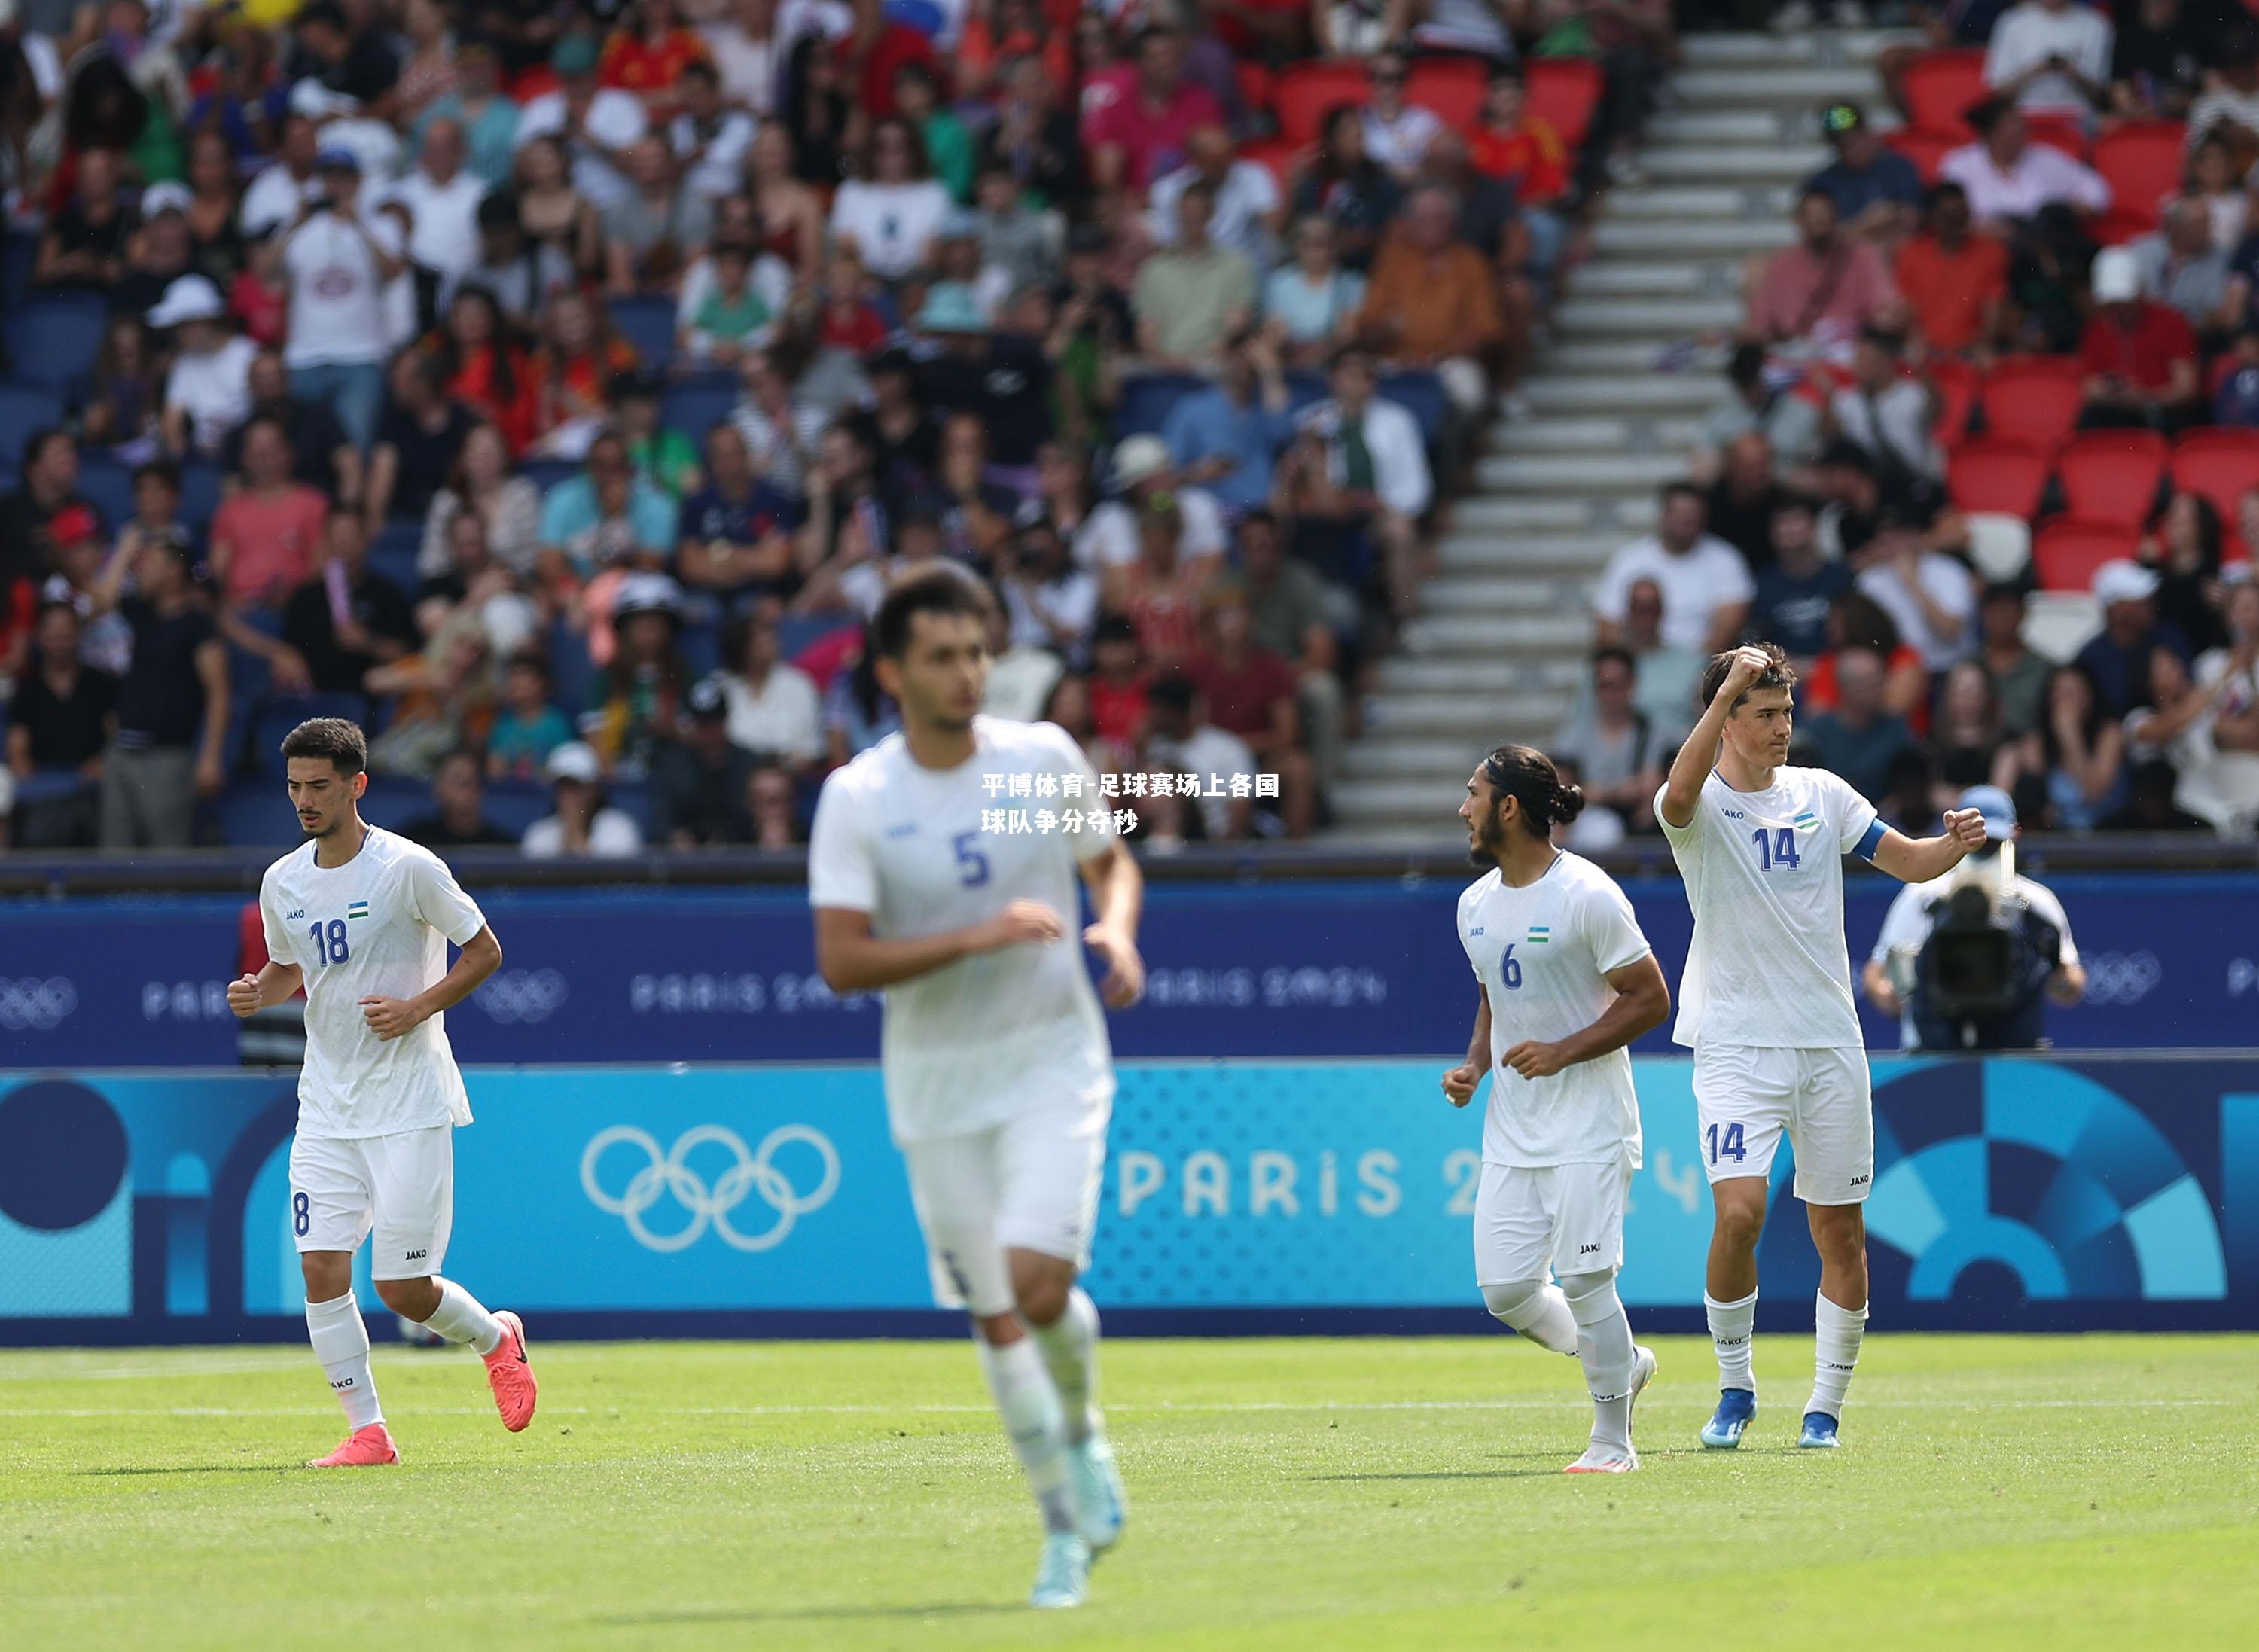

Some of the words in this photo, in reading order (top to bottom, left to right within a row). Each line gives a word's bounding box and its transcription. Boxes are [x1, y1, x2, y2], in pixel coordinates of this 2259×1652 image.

[952, 830, 991, 888] 5
[1752, 828, 1800, 872] 14
[286, 909, 305, 919] JAKO
[309, 919, 349, 967] 18
[1500, 943, 1522, 990] 6
[1706, 1122, 1747, 1166] 14
[1849, 1174, 1869, 1187] JAKO
[293, 1191, 310, 1237] 8
[405, 1249, 427, 1260] JAKO
[328, 1377, 354, 1390] AKO
